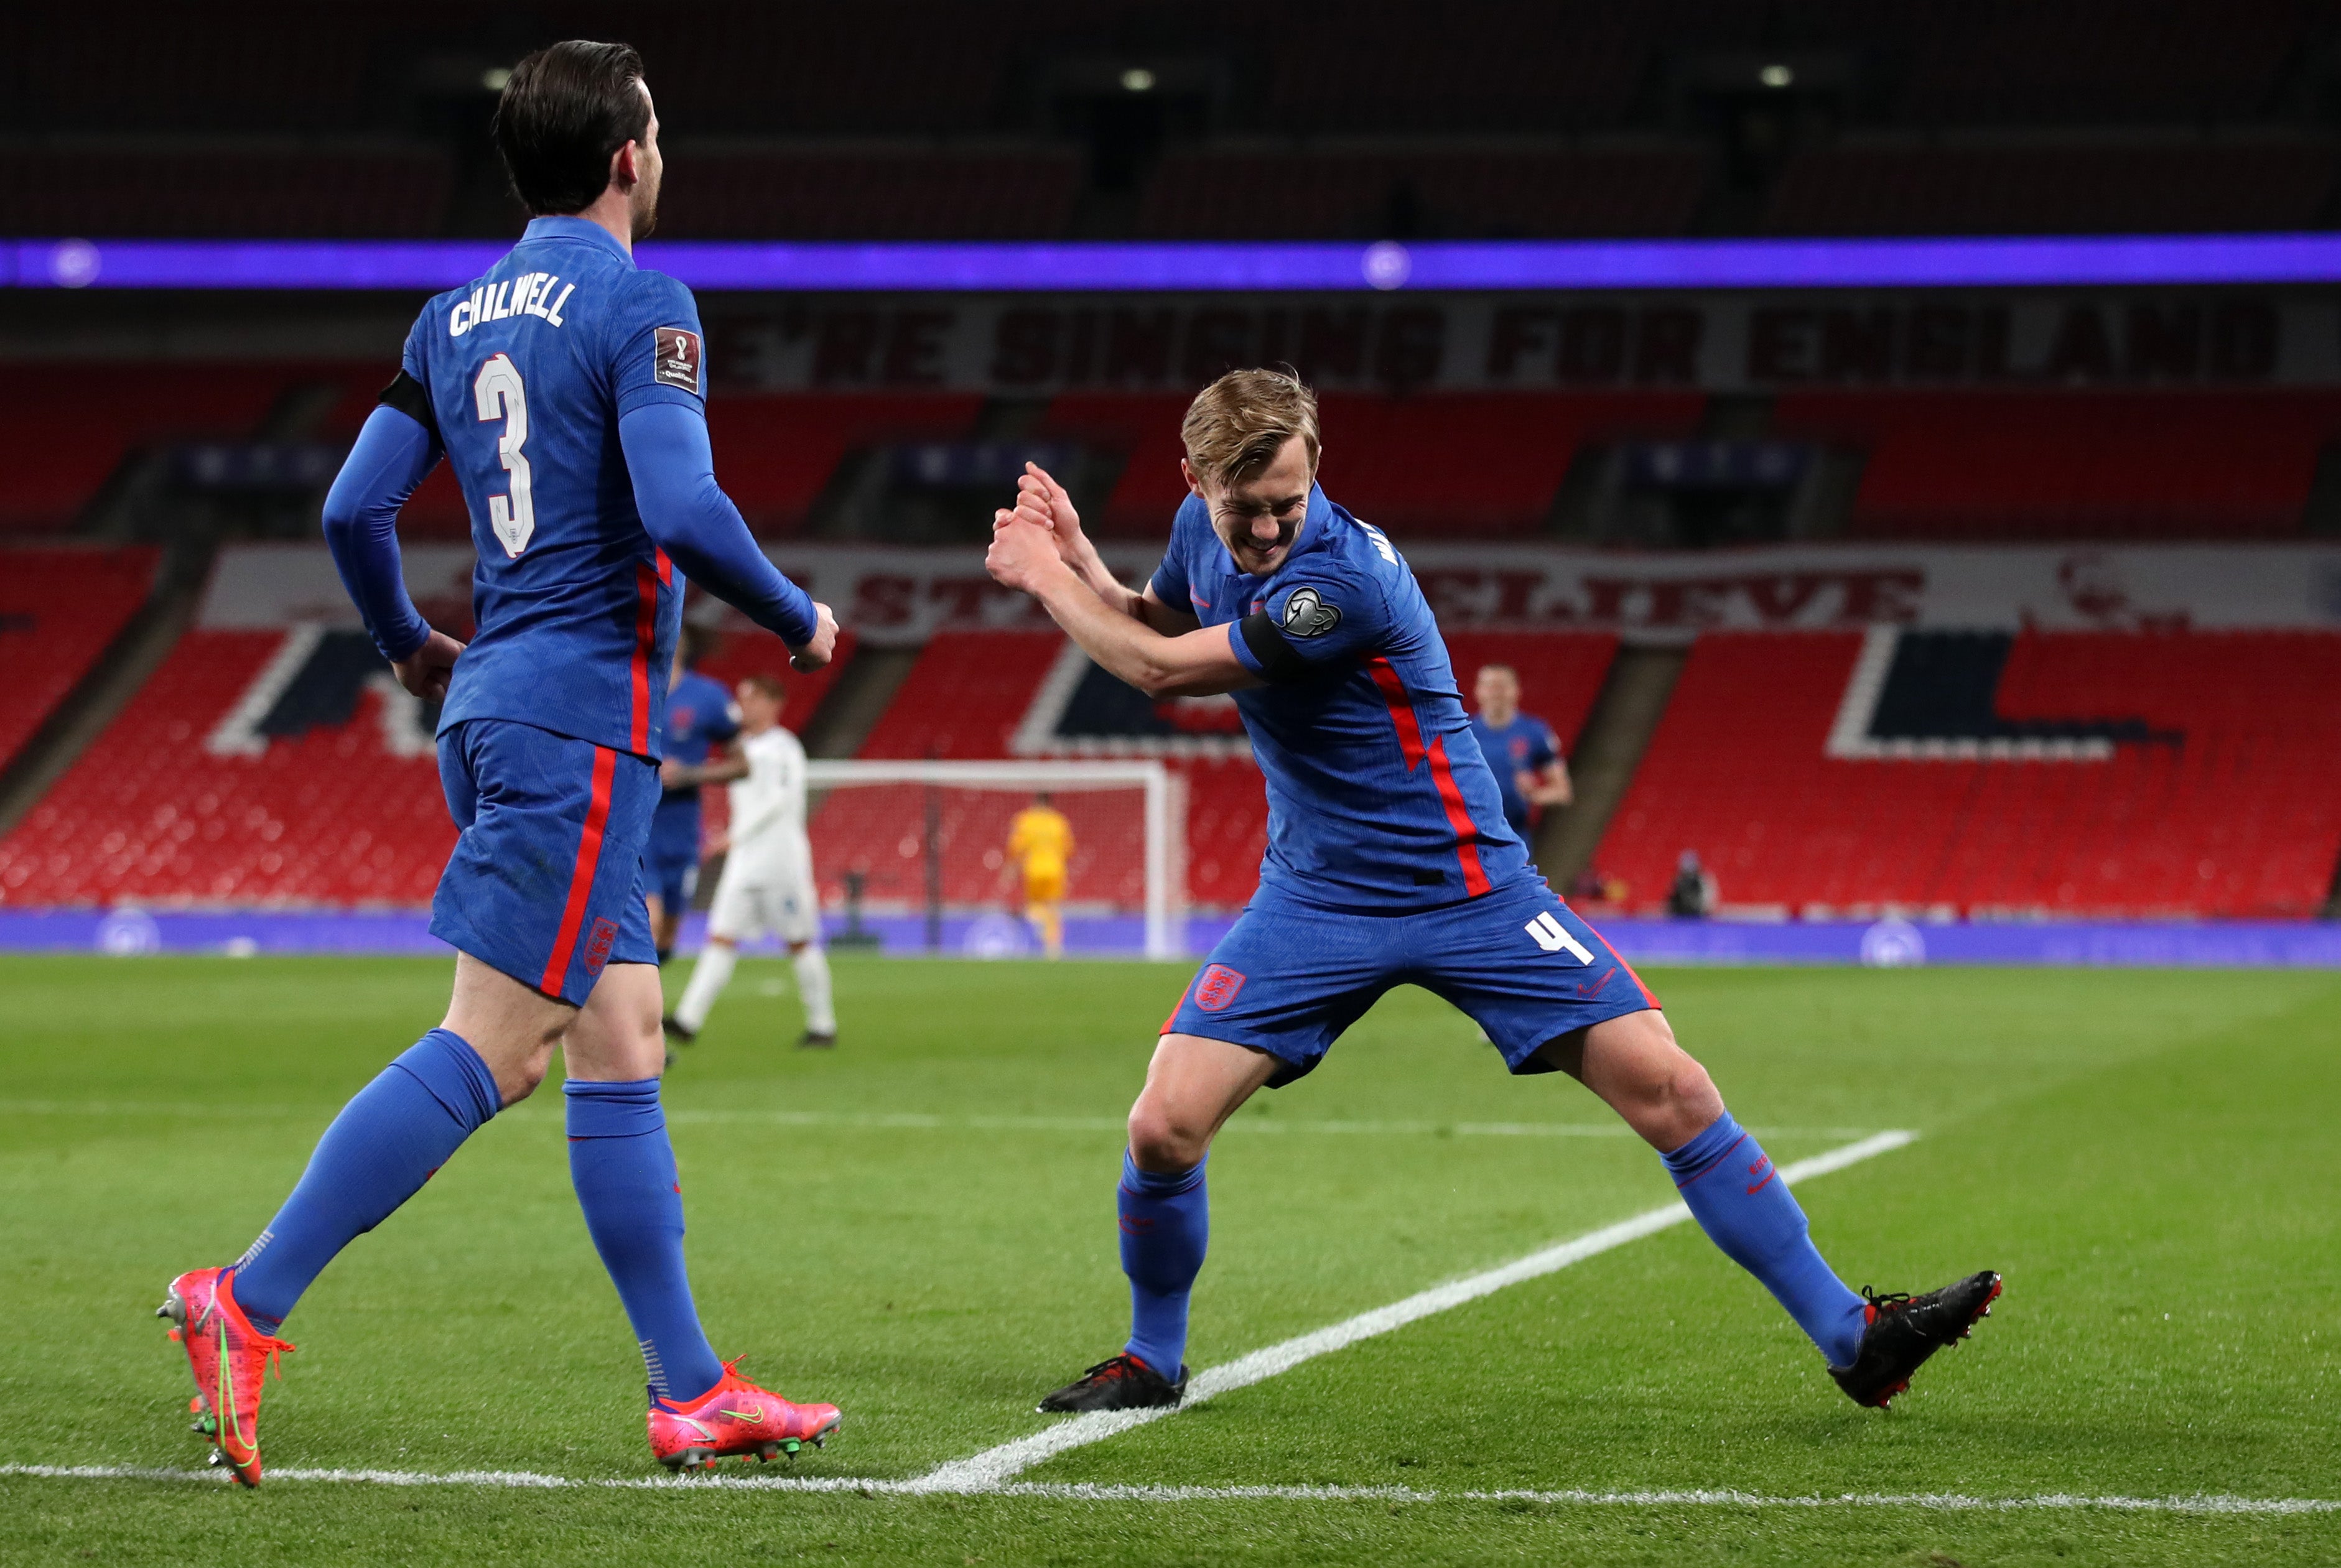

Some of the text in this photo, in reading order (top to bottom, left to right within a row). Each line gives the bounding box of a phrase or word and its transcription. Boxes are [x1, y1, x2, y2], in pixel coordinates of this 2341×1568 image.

[449, 272, 575, 337] CHILWELL
[709, 300, 2281, 384] E'RE SINGING FOR ENGLAND
[474, 352, 535, 559] 3
[1415, 568, 1925, 623] ELIEVE
[1524, 911, 1595, 966] 4
